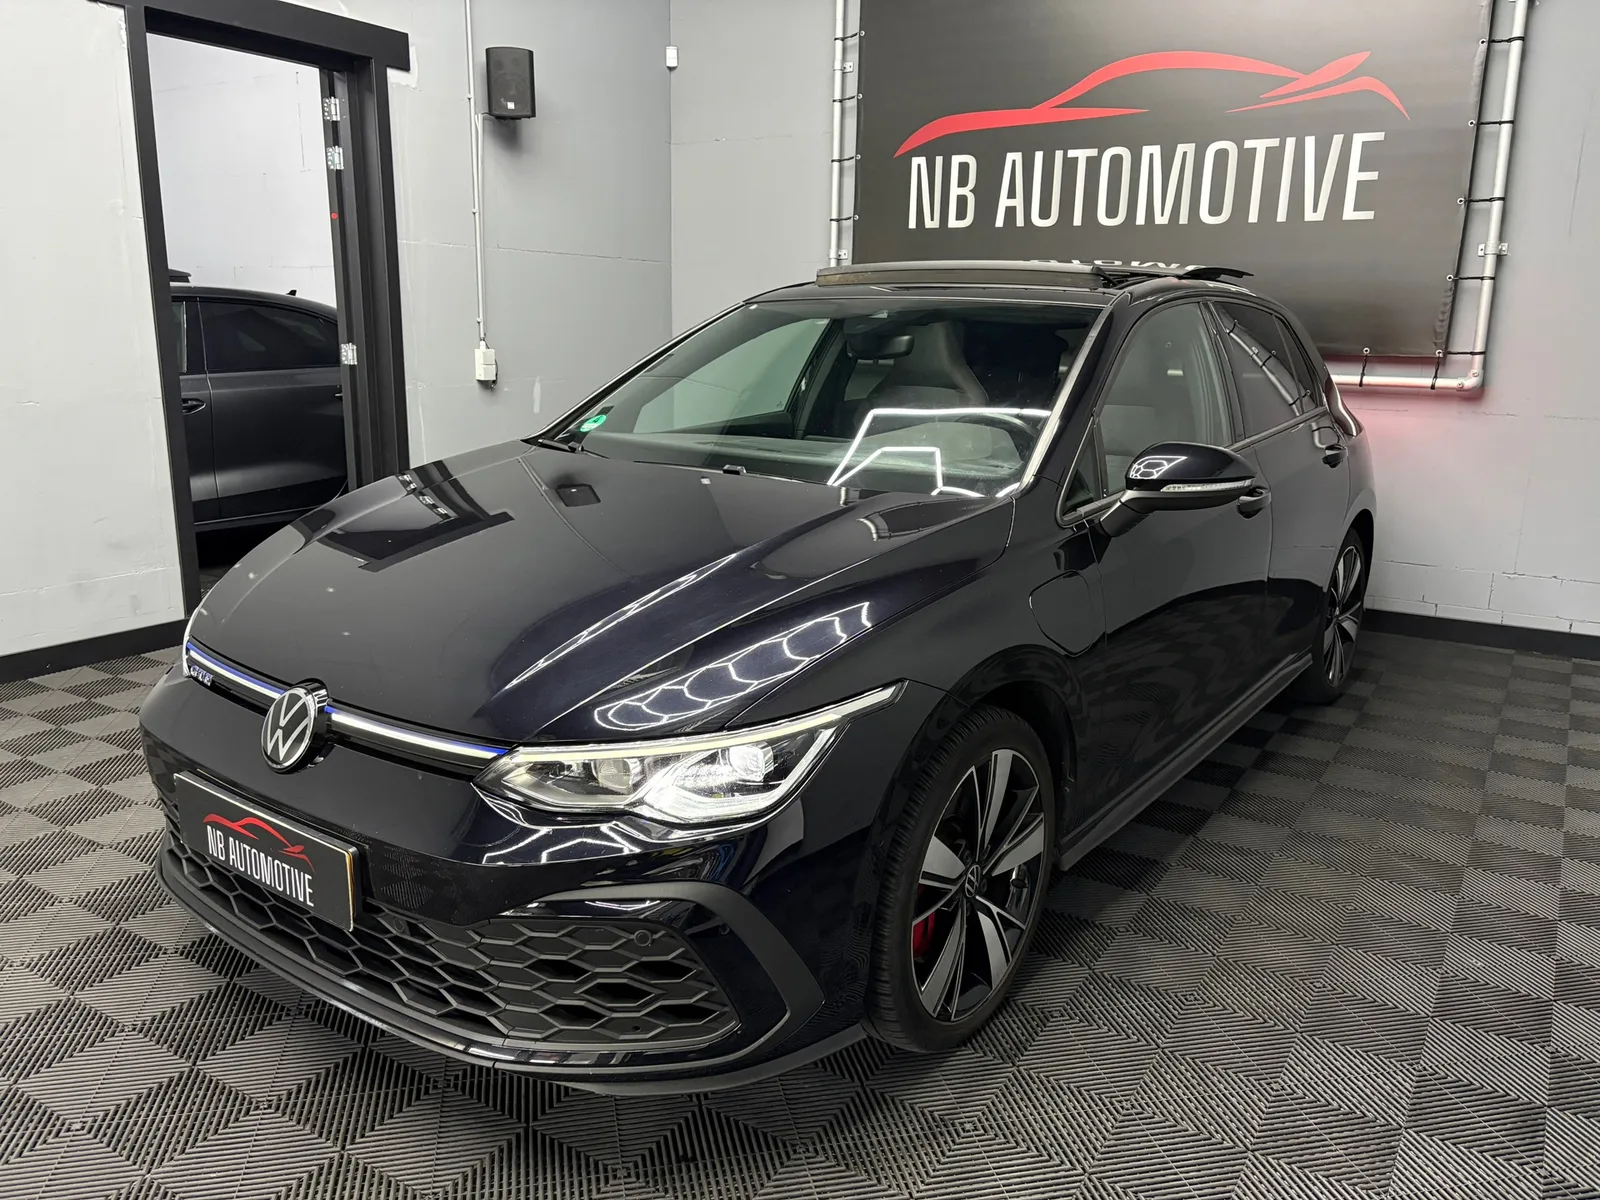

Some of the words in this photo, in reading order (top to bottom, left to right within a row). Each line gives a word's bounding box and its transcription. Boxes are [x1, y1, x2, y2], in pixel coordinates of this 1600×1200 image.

[908, 154, 977, 229] NB
[994, 131, 1386, 228] AUTOMOTIVE
[206, 825, 226, 861] NB
[229, 836, 314, 907] AUTOMOTIVE
